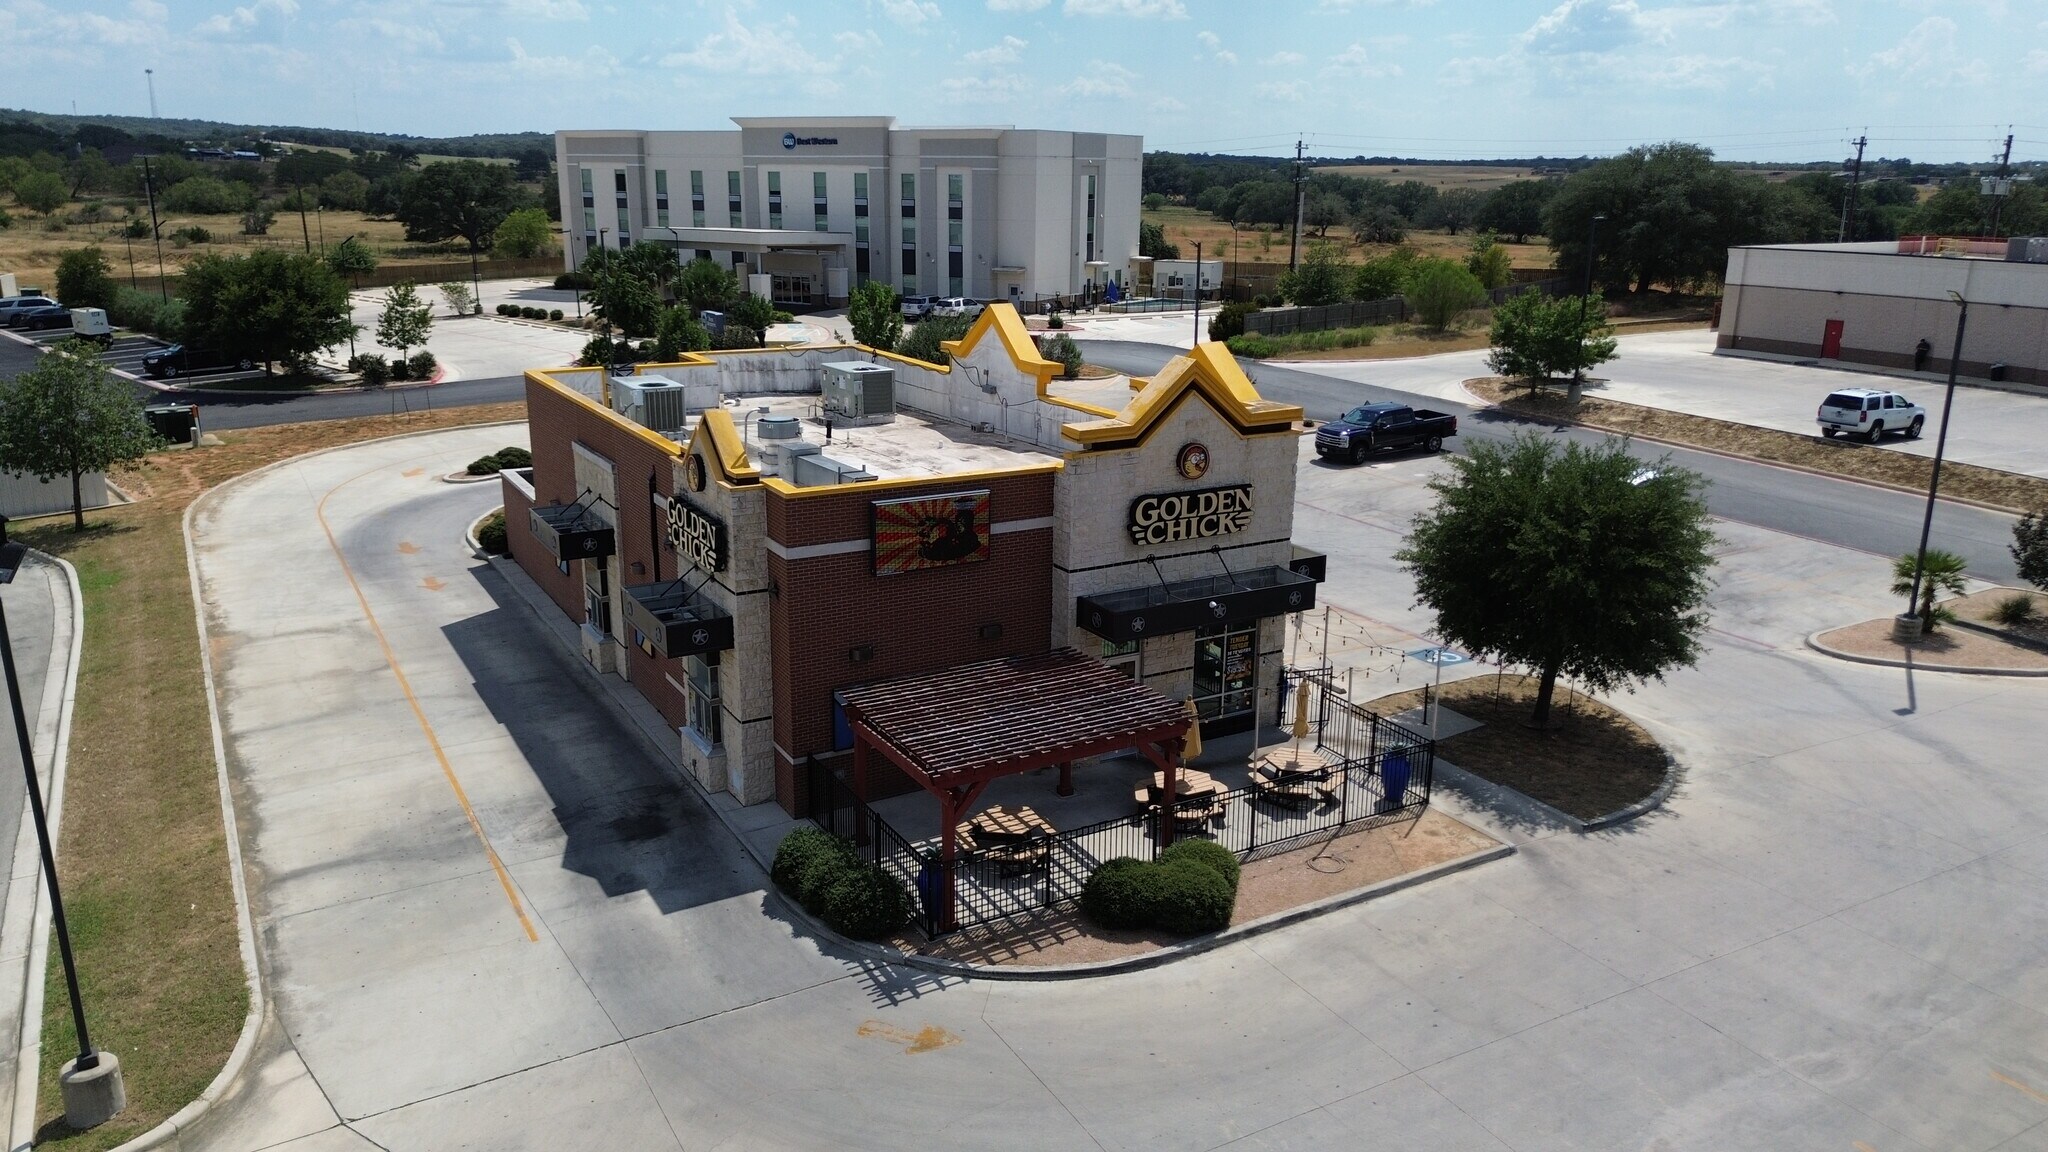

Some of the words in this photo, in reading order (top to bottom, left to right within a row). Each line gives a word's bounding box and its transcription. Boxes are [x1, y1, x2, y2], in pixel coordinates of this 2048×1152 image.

[667, 496, 716, 550] GOLDEN
[1135, 487, 1255, 526] GOLDEN
[672, 524, 711, 570] CHICK
[1146, 512, 1240, 544] CHICK
